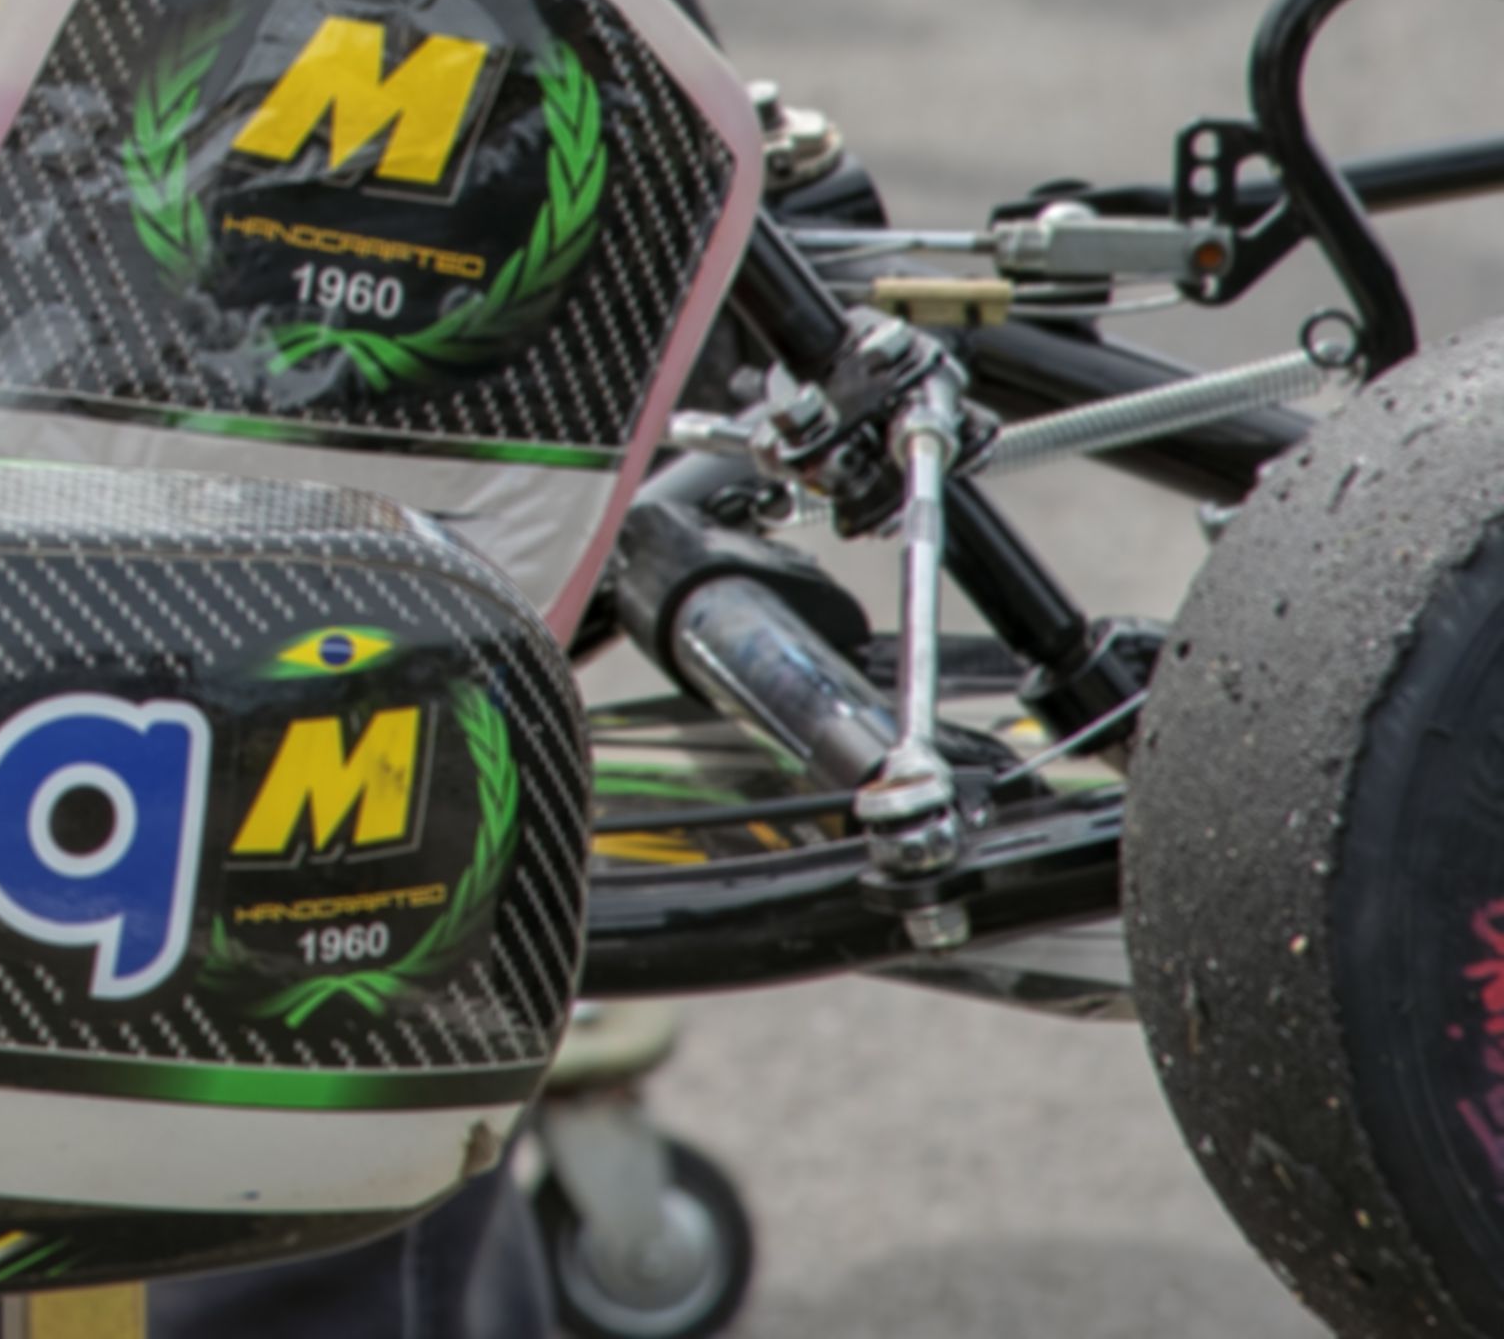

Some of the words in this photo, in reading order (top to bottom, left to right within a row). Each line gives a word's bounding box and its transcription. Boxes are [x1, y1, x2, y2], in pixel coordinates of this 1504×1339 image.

[230, 15, 489, 187] M
[291, 263, 404, 320] 1960
[230, 704, 421, 854] M
[297, 920, 392, 965] 1960
